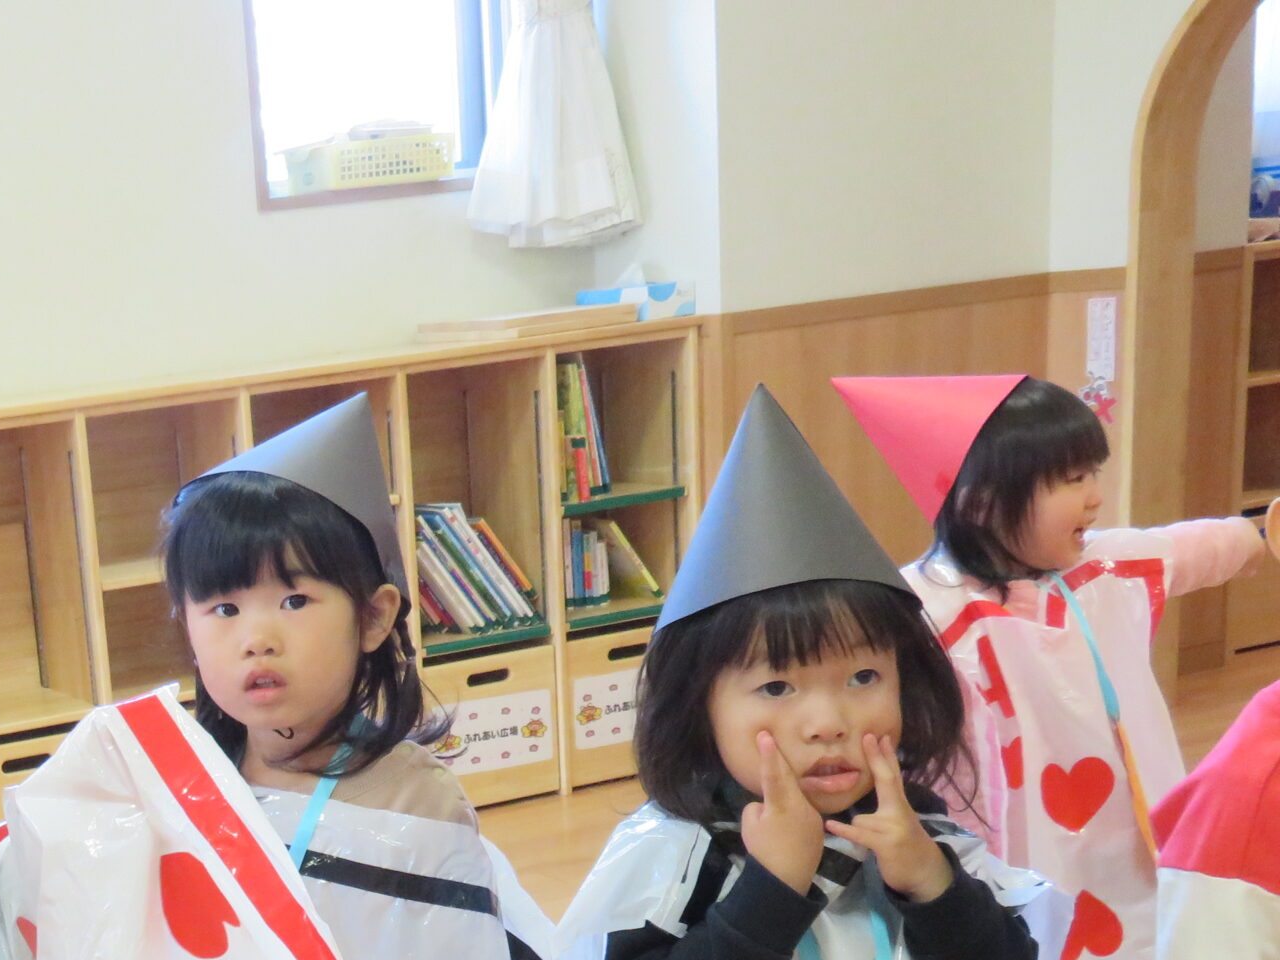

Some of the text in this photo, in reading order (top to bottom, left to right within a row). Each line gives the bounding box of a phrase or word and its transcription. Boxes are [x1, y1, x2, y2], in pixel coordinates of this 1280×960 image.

[464, 726, 519, 744] ふれあい広場
